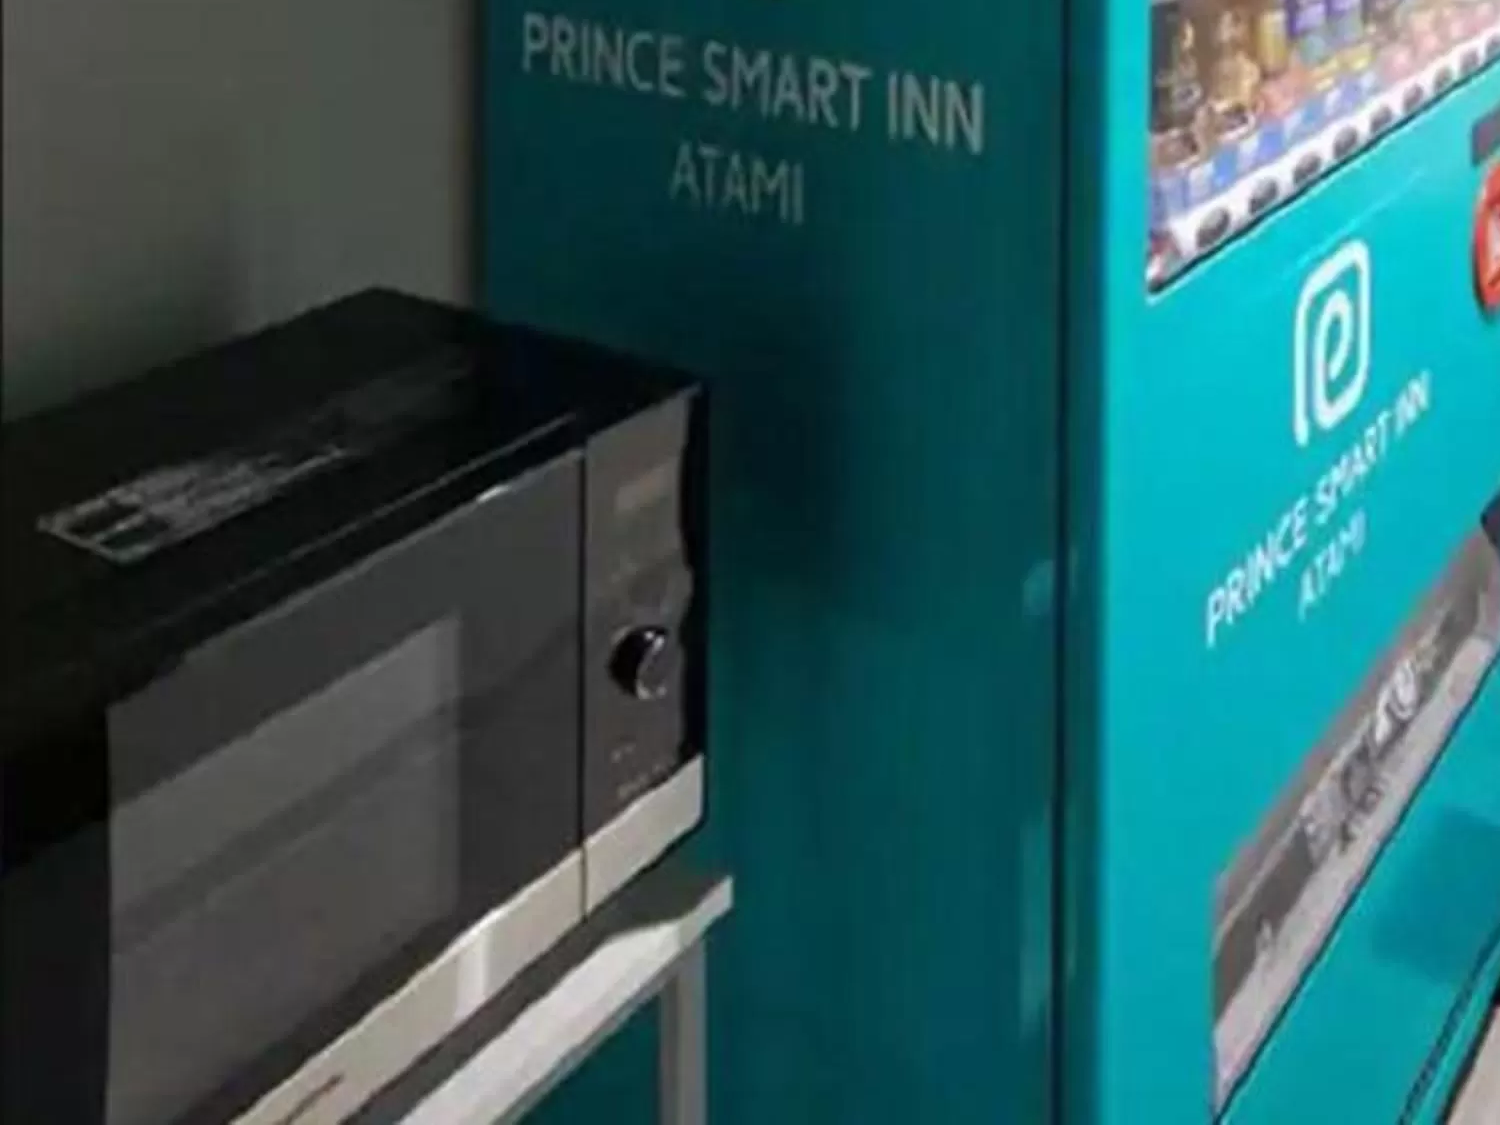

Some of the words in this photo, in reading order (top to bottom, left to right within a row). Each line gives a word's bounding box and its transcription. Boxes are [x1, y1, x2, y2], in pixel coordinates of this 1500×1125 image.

[522, 11, 686, 99] PRINCE
[702, 40, 871, 132] SMART
[887, 71, 985, 156] INN
[669, 140, 806, 225] ATAMI
[1206, 496, 1309, 649] PRINCE
[1314, 409, 1393, 525] SMART
